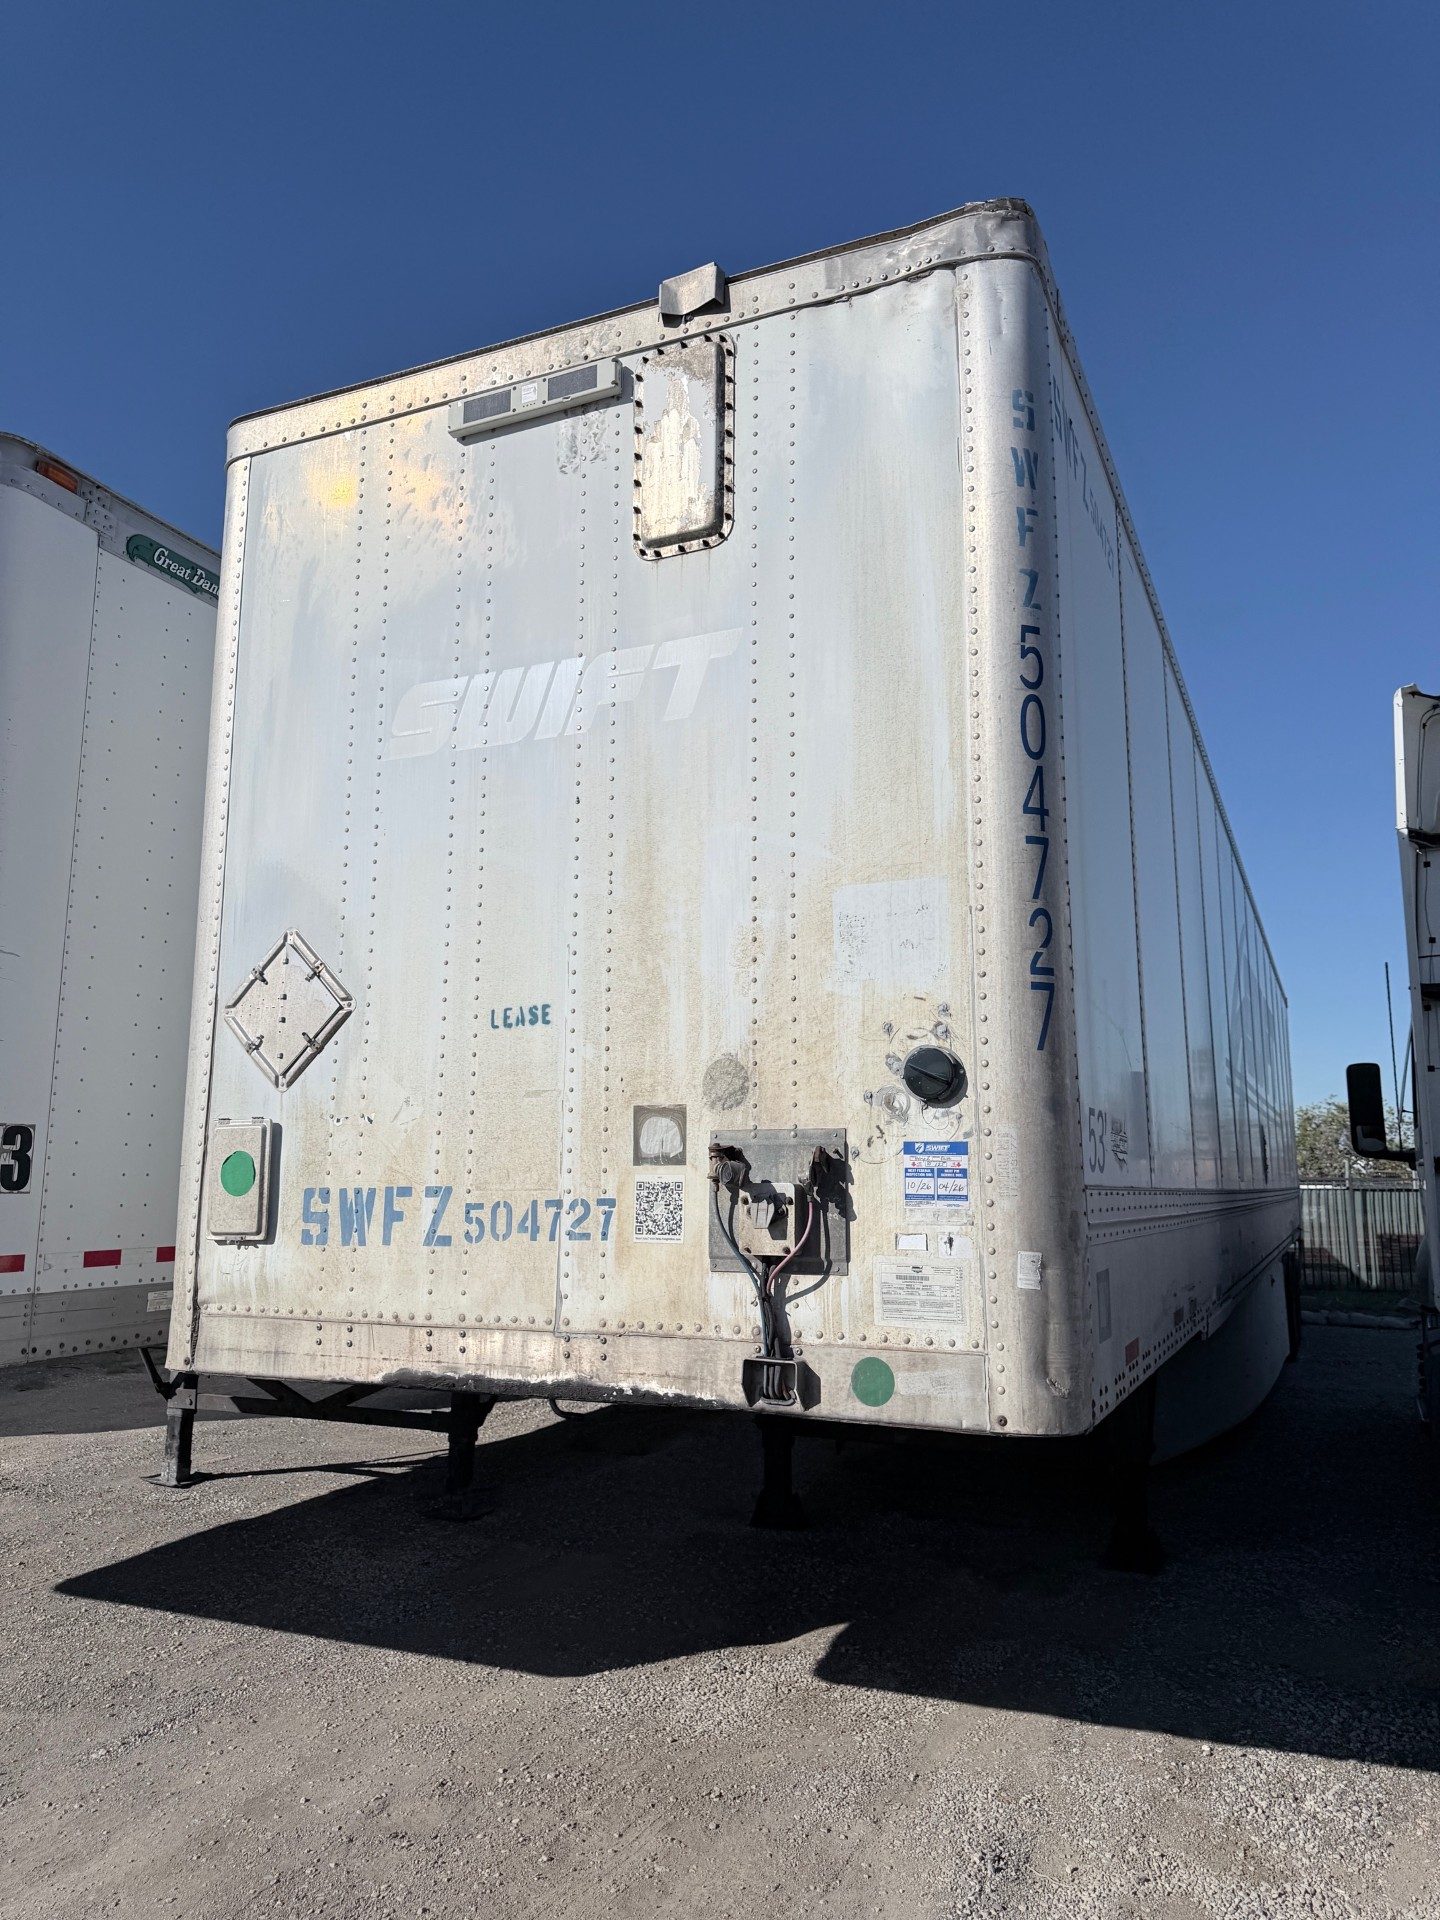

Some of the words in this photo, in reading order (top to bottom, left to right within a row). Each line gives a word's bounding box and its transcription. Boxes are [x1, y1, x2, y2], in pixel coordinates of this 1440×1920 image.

[153, 547, 192, 580] Great
[191, 568, 220, 597] Dan
[382, 628, 743, 761] SWIFT
[490, 1004, 551, 1029] LEASE
[925, 1144, 950, 1152] SWIFT
[907, 1179, 932, 1193] 10/26
[939, 1179, 965, 1194] 04/26
